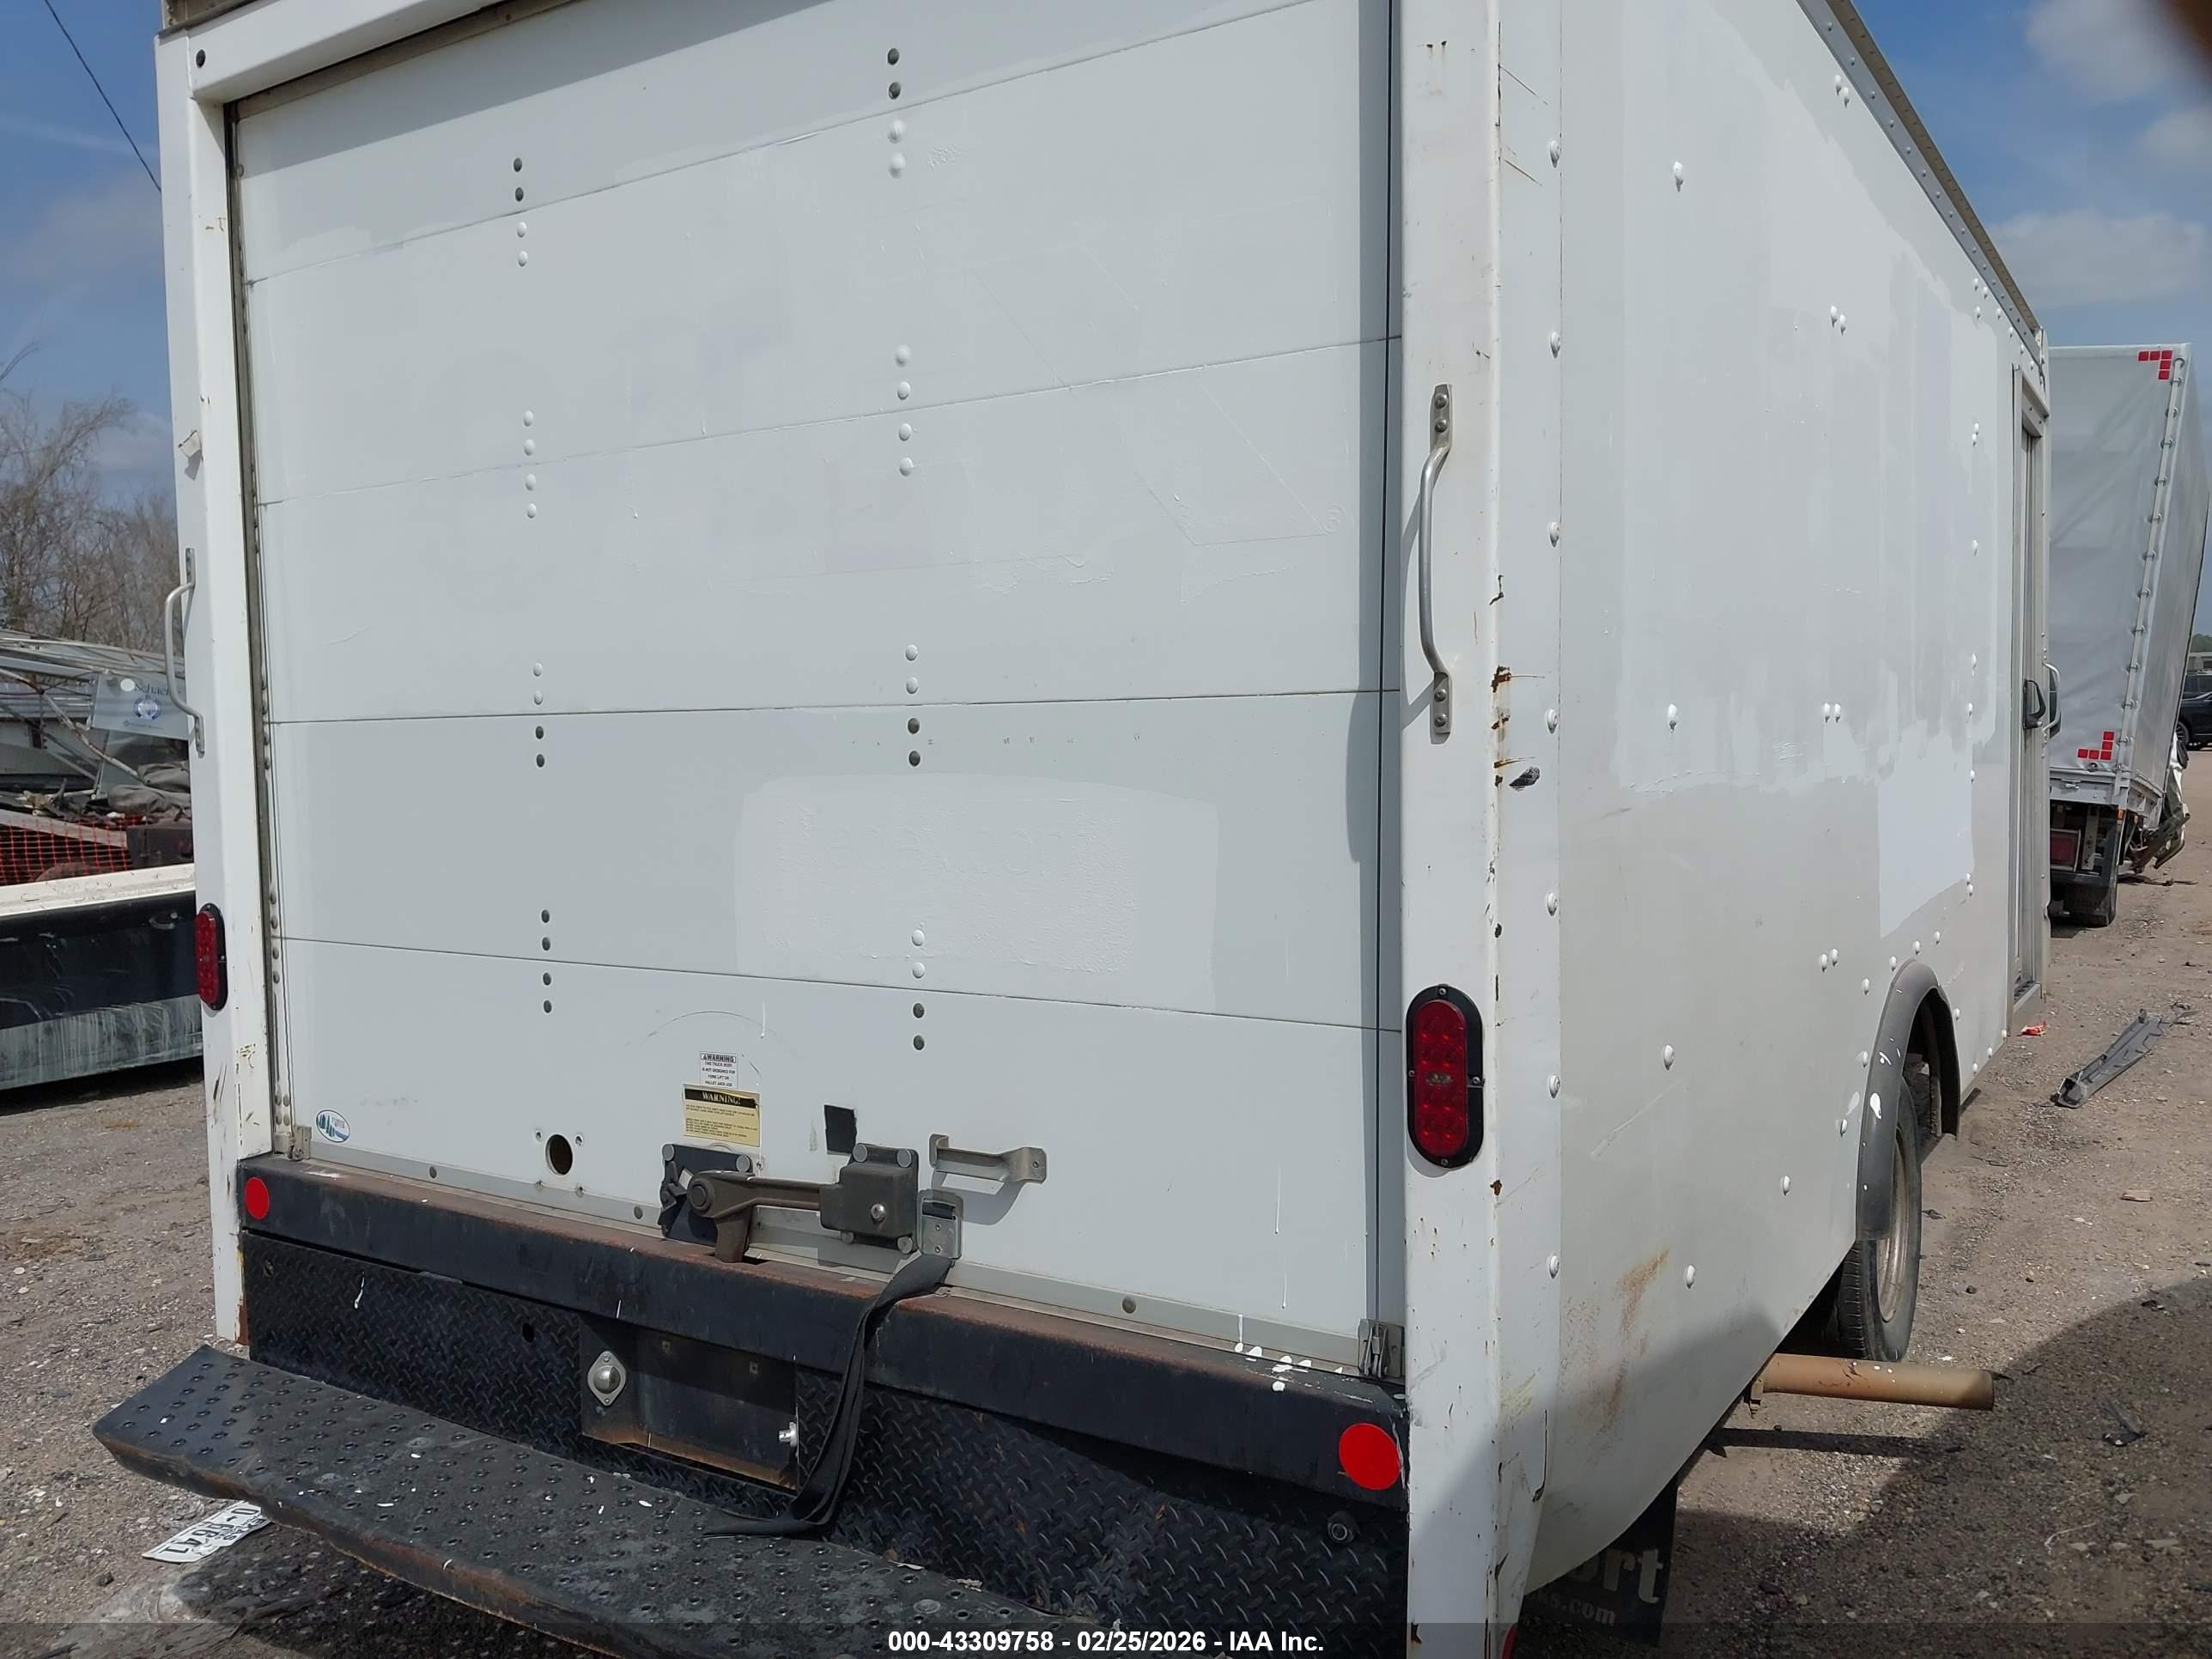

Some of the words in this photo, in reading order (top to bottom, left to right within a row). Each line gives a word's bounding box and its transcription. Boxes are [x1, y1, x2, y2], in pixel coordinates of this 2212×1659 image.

[707, 1054, 734, 1062] WARNING
[702, 1091, 741, 1105] WARNING!
[223, 1518, 267, 1540] EXAS
